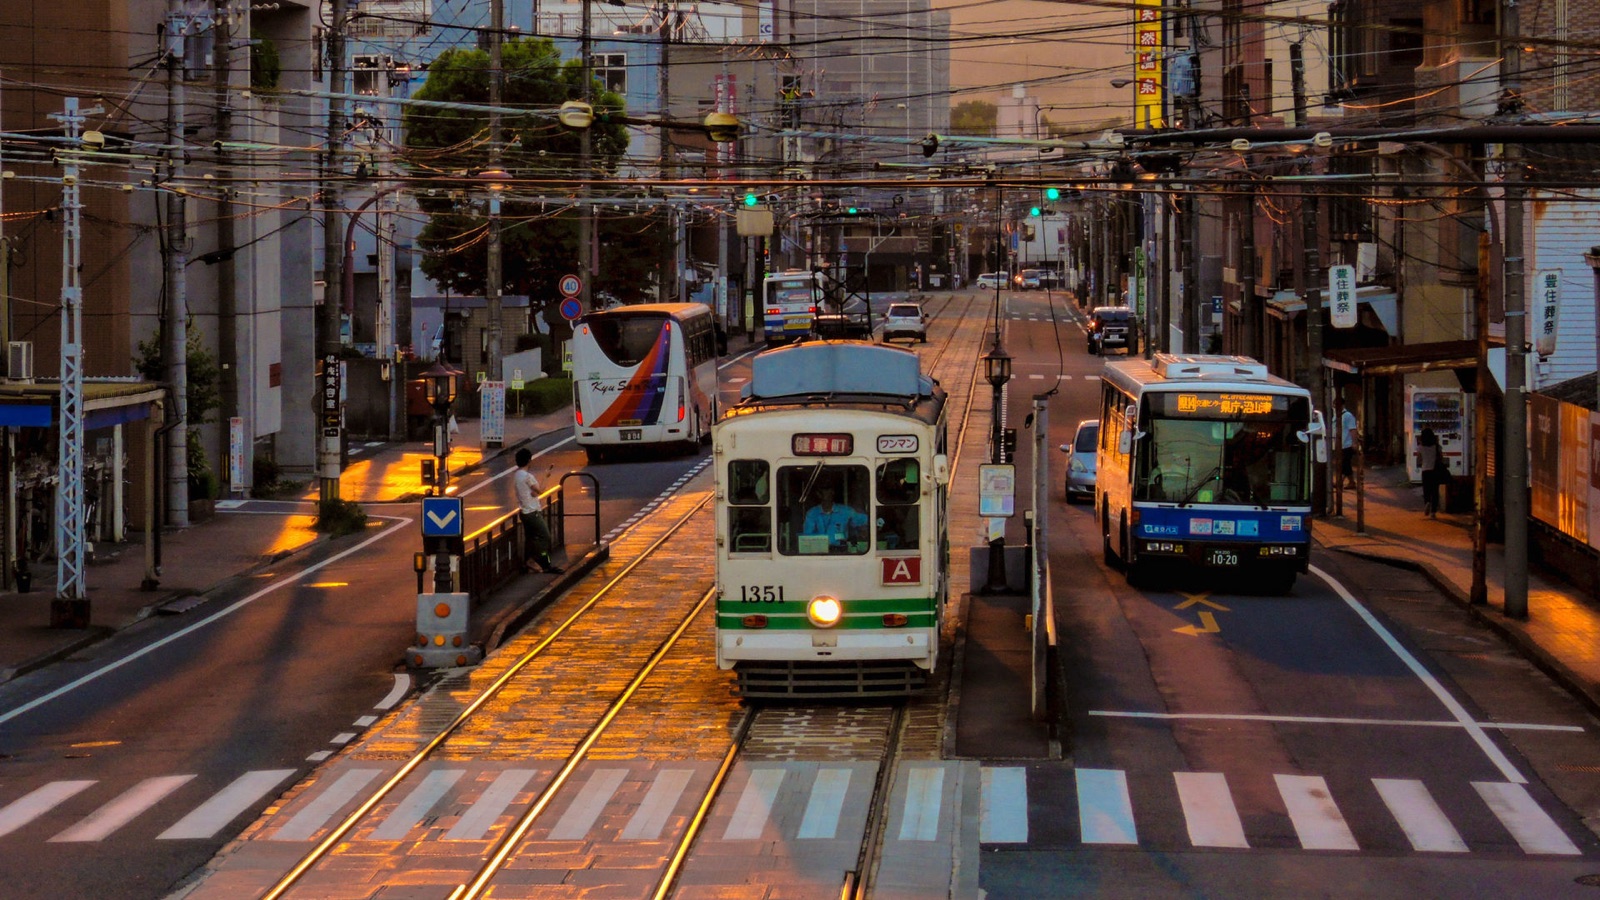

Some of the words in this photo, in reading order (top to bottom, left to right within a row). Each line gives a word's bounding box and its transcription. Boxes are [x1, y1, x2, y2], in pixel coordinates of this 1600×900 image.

[1140, 8, 1156, 95] 天然温泉
[564, 280, 577, 292] 40
[1335, 268, 1351, 314] 豊住葬祭
[1543, 273, 1558, 336] 豊住葬祭
[591, 381, 615, 395] Kyu
[795, 436, 847, 453] 健軍町
[879, 438, 916, 450] ワンマン
[891, 561, 912, 581] A
[740, 584, 786, 605] 1351
